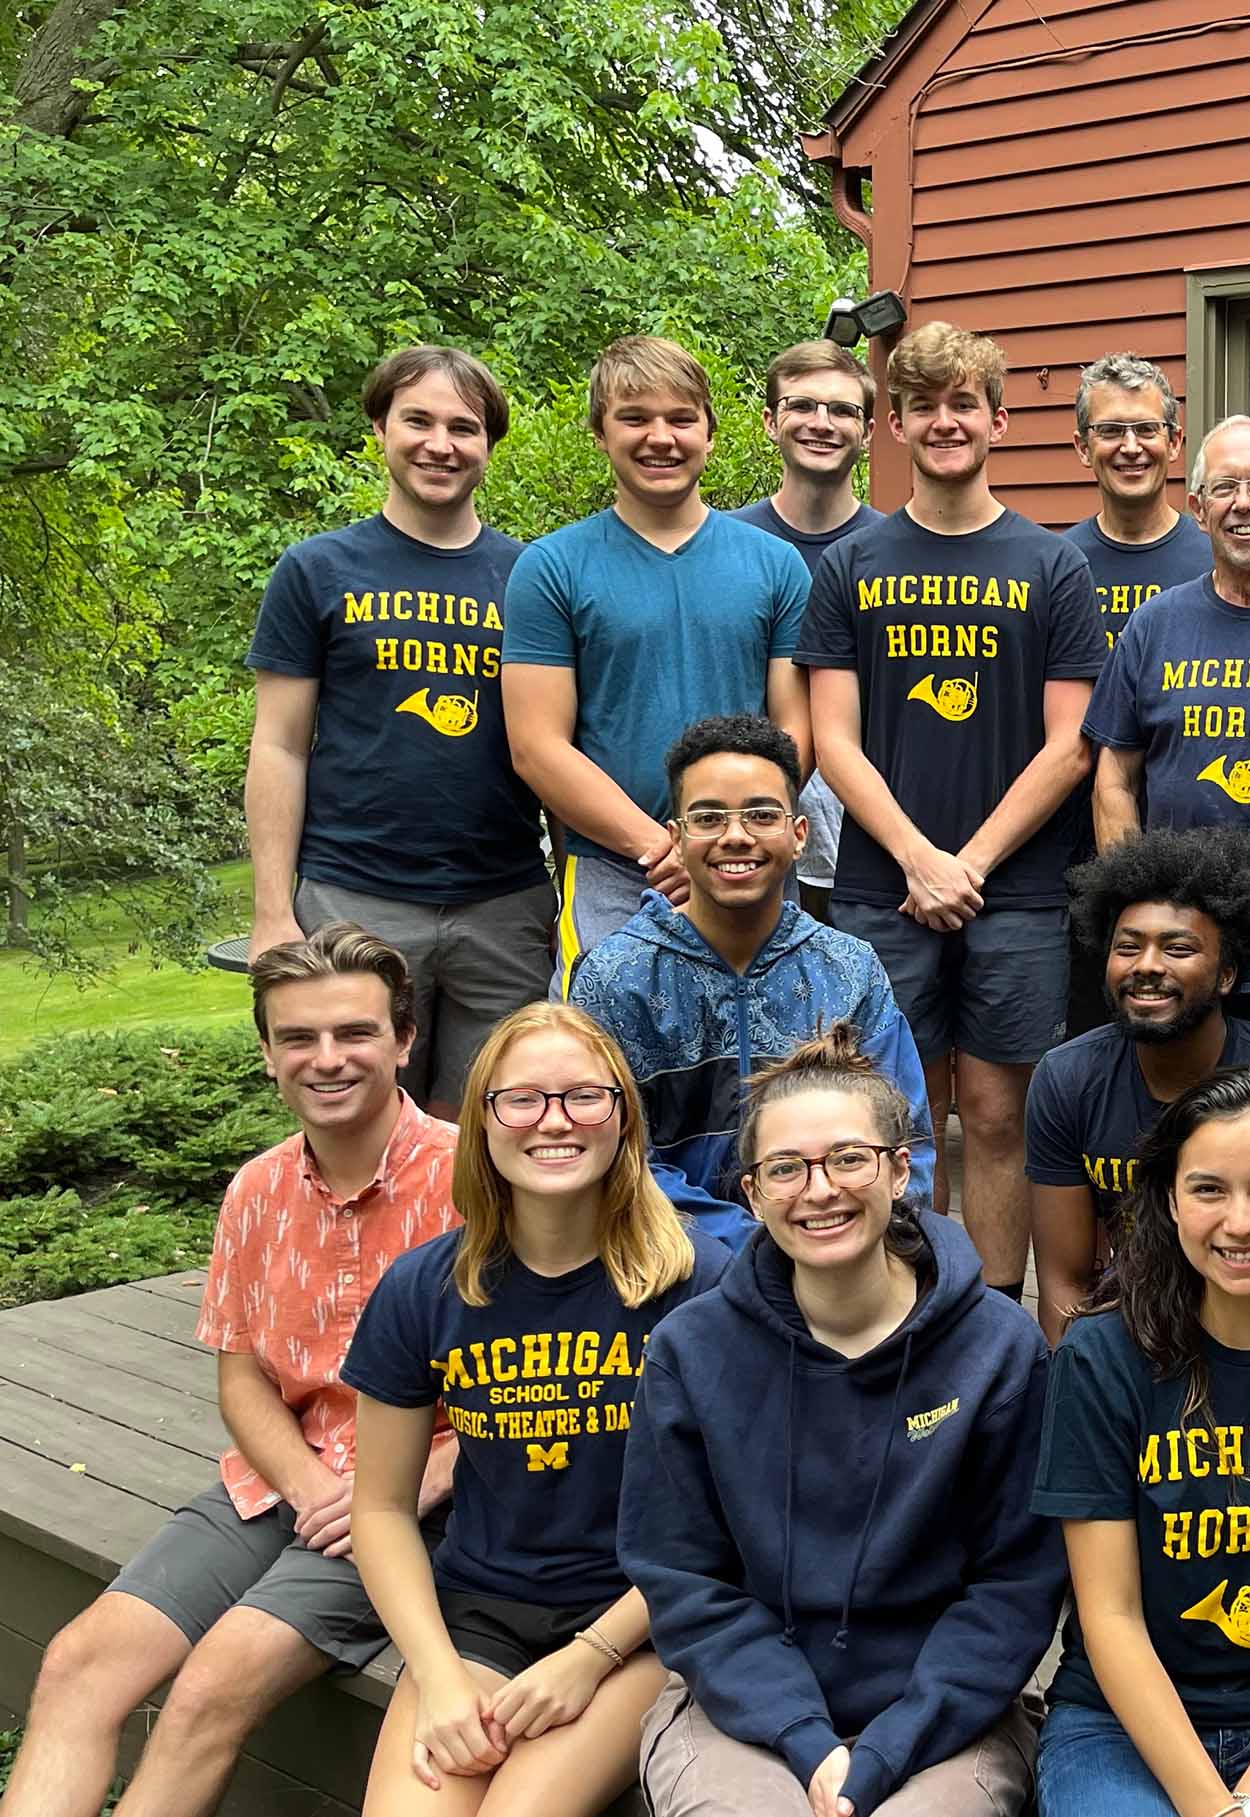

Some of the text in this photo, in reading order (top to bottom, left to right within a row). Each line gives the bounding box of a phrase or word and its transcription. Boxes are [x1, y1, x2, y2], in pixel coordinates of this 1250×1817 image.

[344, 591, 504, 631] MICHIGA
[857, 575, 1031, 612] MICHIGAN
[375, 638, 501, 678] HORNS
[886, 624, 999, 658] HORNS
[489, 1380, 604, 1405] SCHOOL OF
[495, 1407, 581, 1440] THEATRE
[586, 1406, 599, 1434] &
[604, 1401, 635, 1432] DA
[906, 1397, 960, 1431] MICHIGAN
[526, 1441, 571, 1472] M
